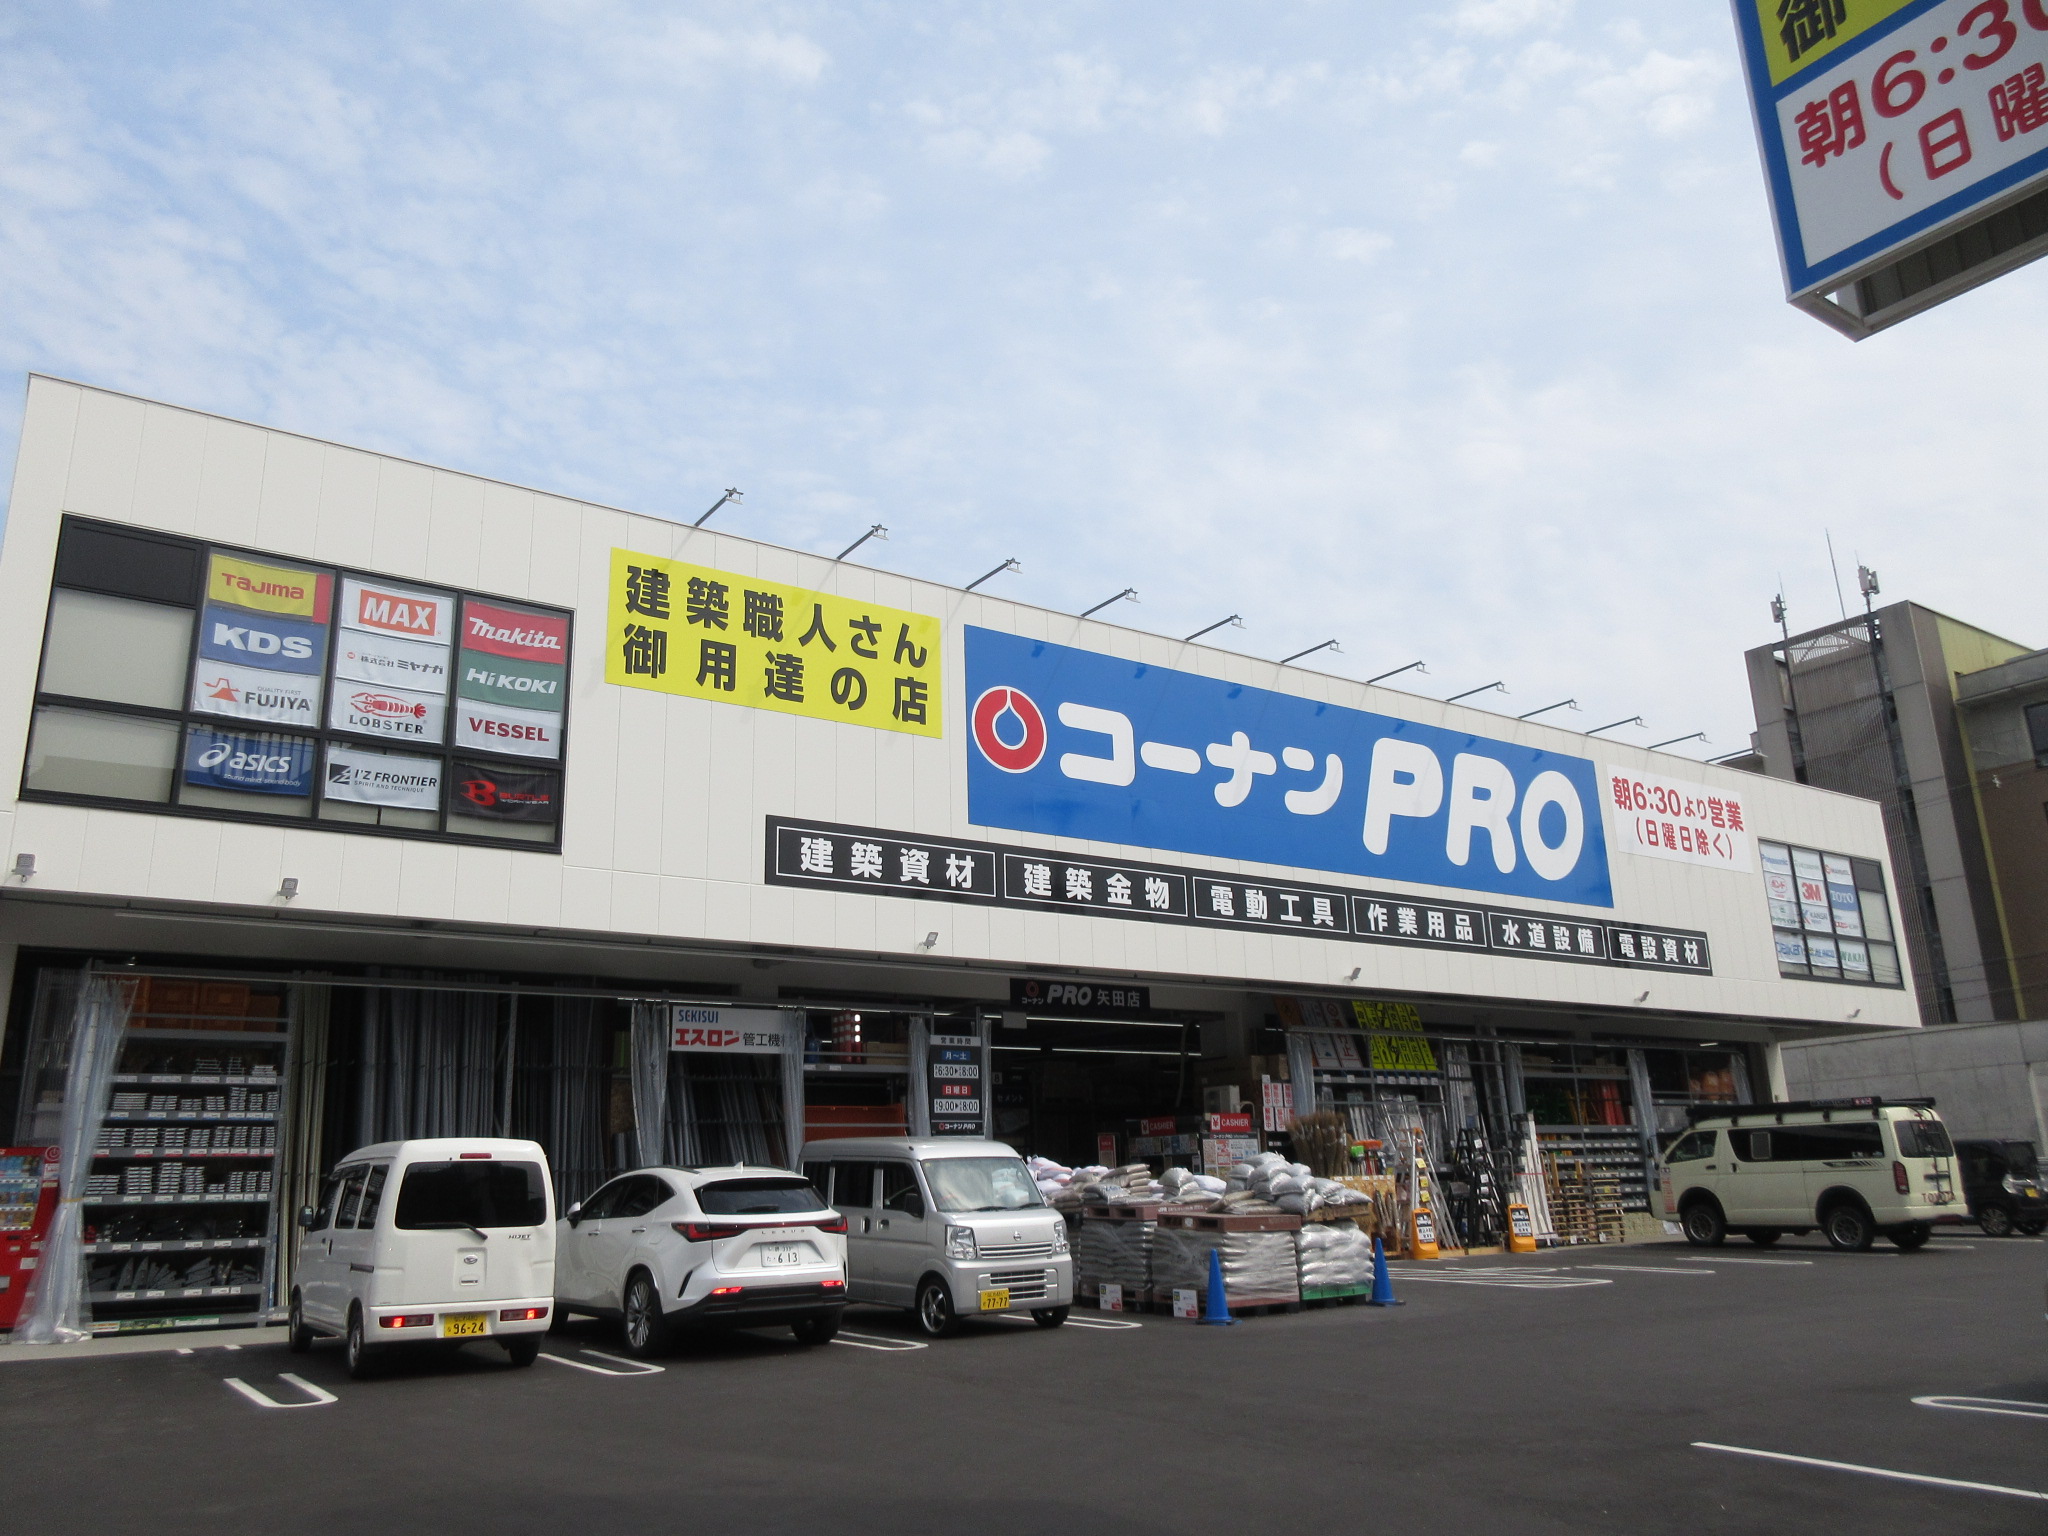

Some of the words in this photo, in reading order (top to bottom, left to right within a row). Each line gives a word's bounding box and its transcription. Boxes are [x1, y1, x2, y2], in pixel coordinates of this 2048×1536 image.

[363, 596, 433, 630] MAX
[625, 564, 928, 669] 建築職人さん
[213, 622, 313, 659] KDS
[623, 623, 928, 726] 御用達の店
[244, 691, 311, 711] FUJIYA
[257, 686, 284, 694] QUALITY
[349, 714, 424, 734] LOBSTER
[468, 717, 549, 741] VESSEL
[354, 780, 375, 788] SPIRIT
[391, 785, 425, 793] TECHNIQUE
[374, 771, 438, 787] FRONTIER
[1057, 701, 1344, 816] コーナン
[1362, 736, 1585, 881] PRO
[1611, 776, 1744, 832] 朝6:30より営業
[800, 837, 975, 889] 建築資材
[1023, 863, 1170, 910] 建築金物
[1802, 881, 1822, 902] 3M
[1830, 890, 1854, 904] TOTO
[1210, 884, 1334, 927] 電動工具
[1367, 903, 1474, 941] 作業用品
[1502, 919, 1595, 954] 水道設備
[1618, 933, 1699, 965] 電設資材
[1047, 984, 1092, 1006] PRO
[1097, 988, 1140, 1008] 矢田店
[678, 1009, 719, 1024] SEKISUI
[675, 1028, 740, 1047] エスロン
[945, 1085, 968, 1095] 日曜日
[1221, 1118, 1249, 1127] CASHIER
[453, 1322, 484, 1334] 96-24
